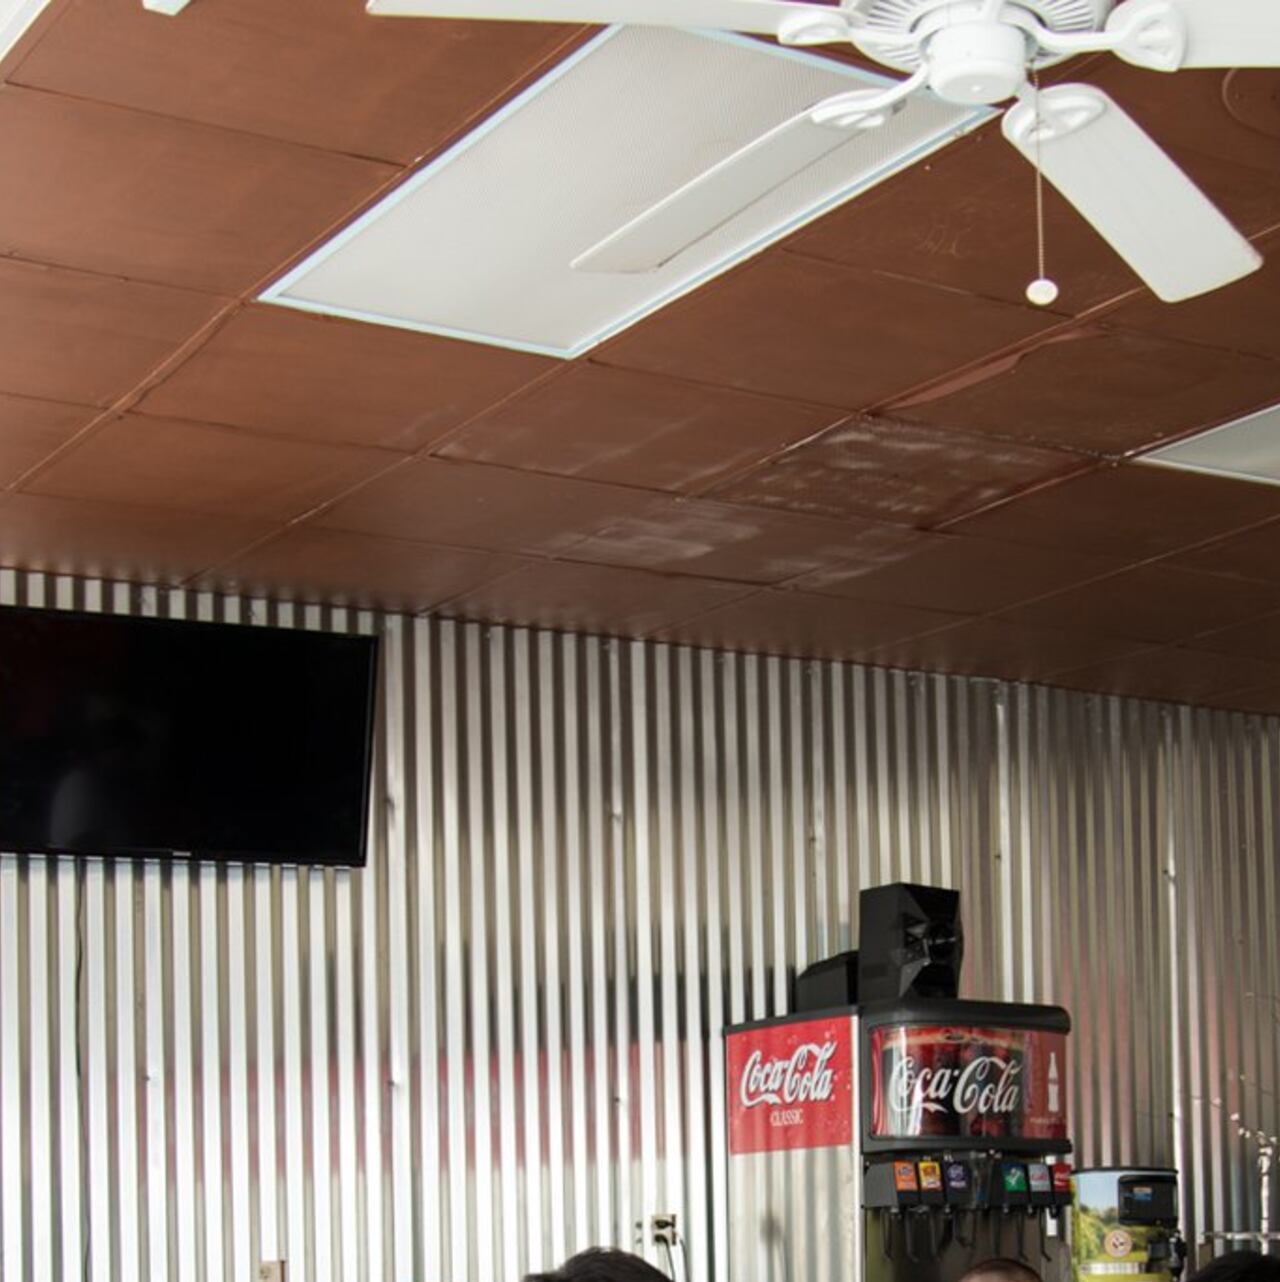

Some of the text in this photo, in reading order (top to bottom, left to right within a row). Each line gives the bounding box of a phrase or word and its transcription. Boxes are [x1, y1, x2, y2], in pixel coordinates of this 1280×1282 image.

[741, 1041, 838, 1107] Coca-Cola
[888, 1055, 1023, 1114] Coca-Cola
[770, 1108, 804, 1127] CLASSIC
